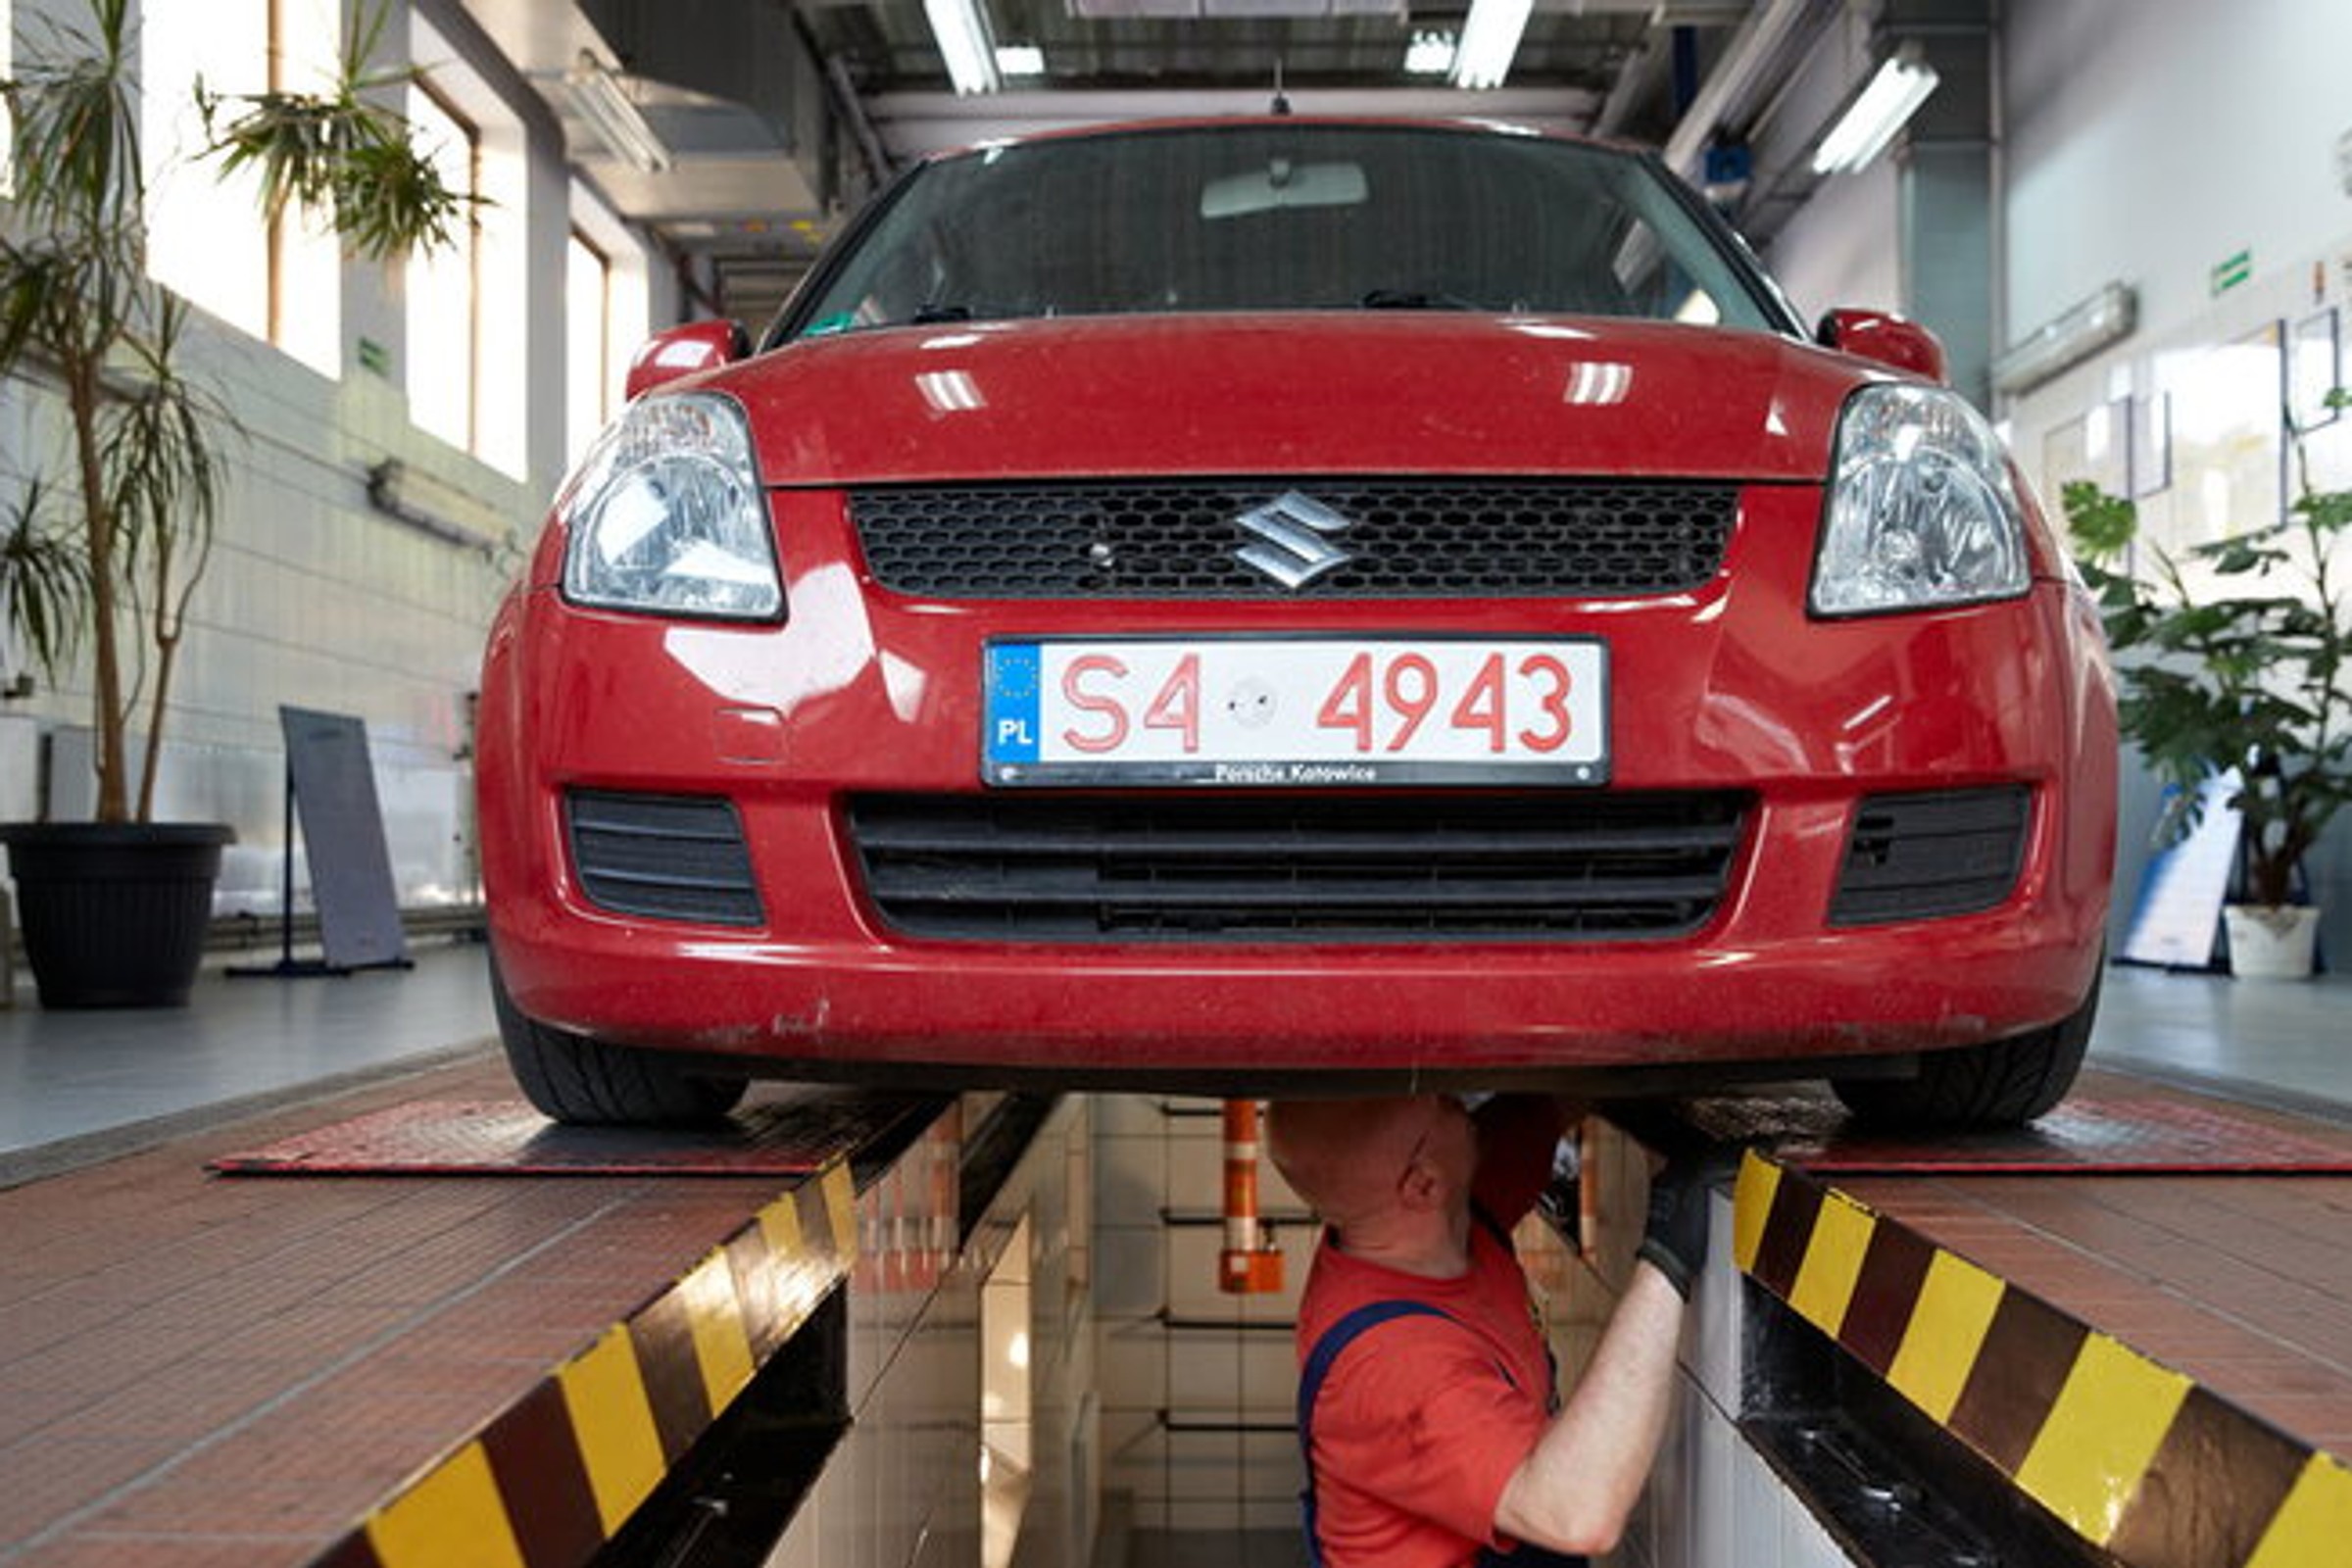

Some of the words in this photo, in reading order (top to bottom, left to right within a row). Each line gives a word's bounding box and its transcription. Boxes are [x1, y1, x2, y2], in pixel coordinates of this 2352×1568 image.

[998, 718, 1033, 745] PL
[1061, 652, 1200, 754] S4
[1316, 652, 1572, 753] 4943
